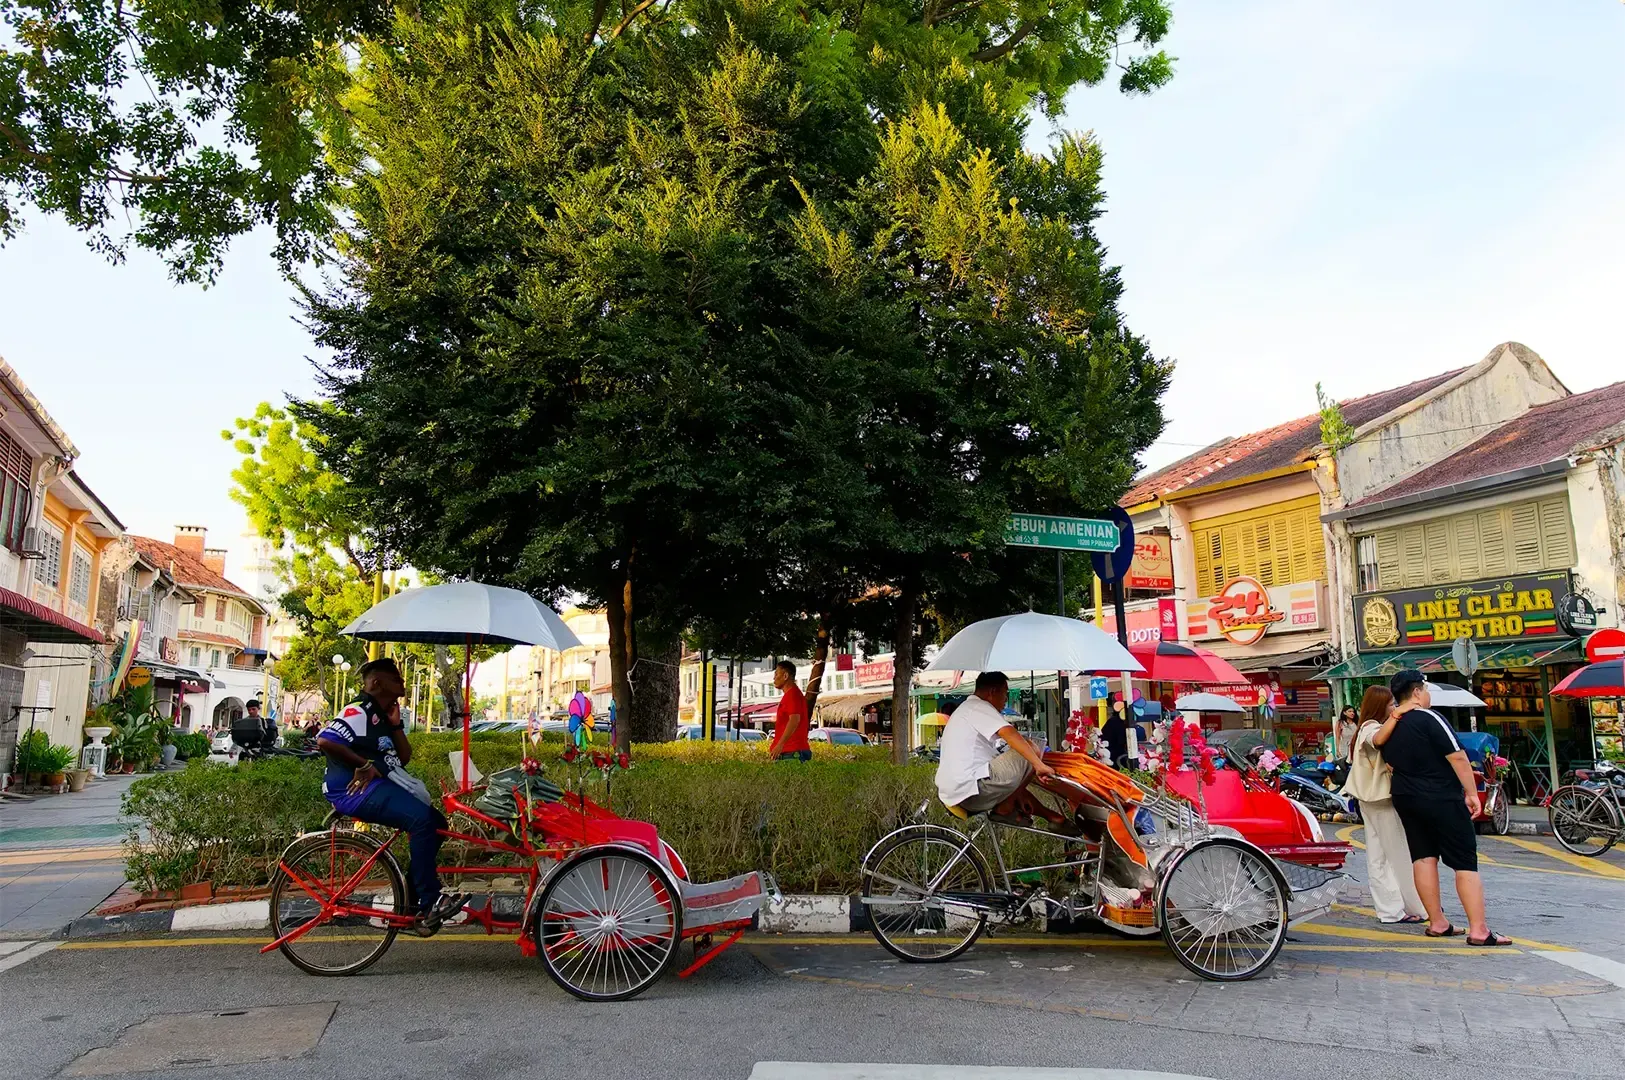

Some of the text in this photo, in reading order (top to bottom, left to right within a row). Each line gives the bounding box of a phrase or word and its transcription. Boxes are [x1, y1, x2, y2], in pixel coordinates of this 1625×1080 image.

[1050, 520, 1114, 539] ARMENIAN
[1148, 578, 1158, 587] 24
[1208, 590, 1264, 620] 24
[1404, 588, 1555, 623] LINE CLEAR
[1131, 627, 1161, 643] DOTS
[1432, 614, 1524, 642] BISTRO
[1231, 685, 1253, 693] TANPA
